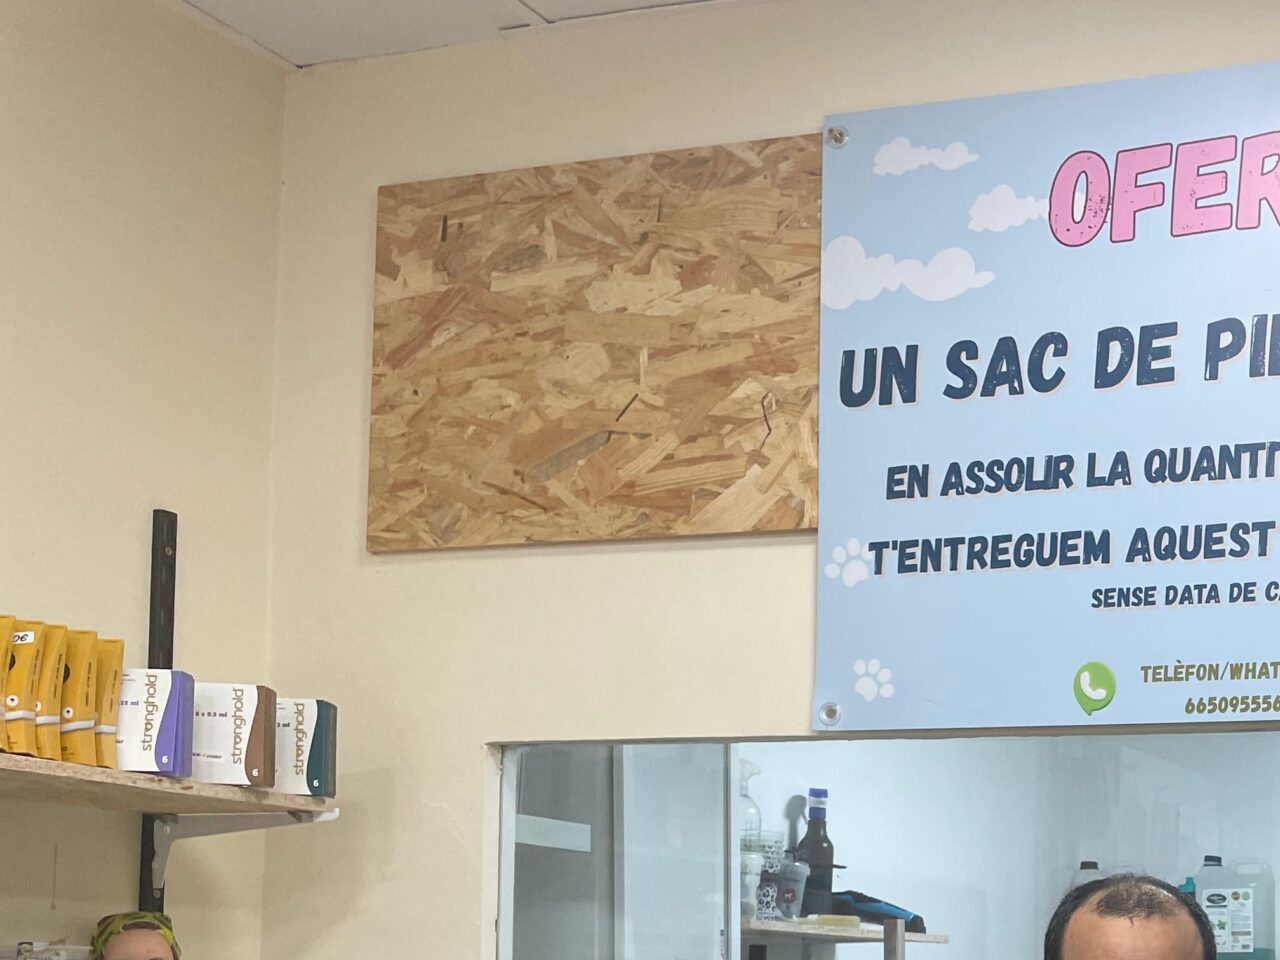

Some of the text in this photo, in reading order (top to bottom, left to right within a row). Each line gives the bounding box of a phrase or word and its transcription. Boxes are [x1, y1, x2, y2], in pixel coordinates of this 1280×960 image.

[839, 344, 919, 408] UN
[943, 332, 1067, 399] SAC
[1094, 322, 1179, 389] DE
[885, 464, 929, 499] EN
[940, 456, 1074, 497] ASSOLIR
[1087, 453, 1131, 488] LA
[868, 530, 1110, 577] T'ENTREGUEM
[1126, 521, 1275, 563] AQUEST
[1091, 586, 1157, 609] SENSE
[1164, 583, 1221, 606] DATA
[1229, 581, 1257, 603] DE
[141, 674, 158, 751] stronghold
[232, 688, 246, 764] stronghold
[294, 702, 307, 776] stronghold
[313, 779, 319, 787] 6
